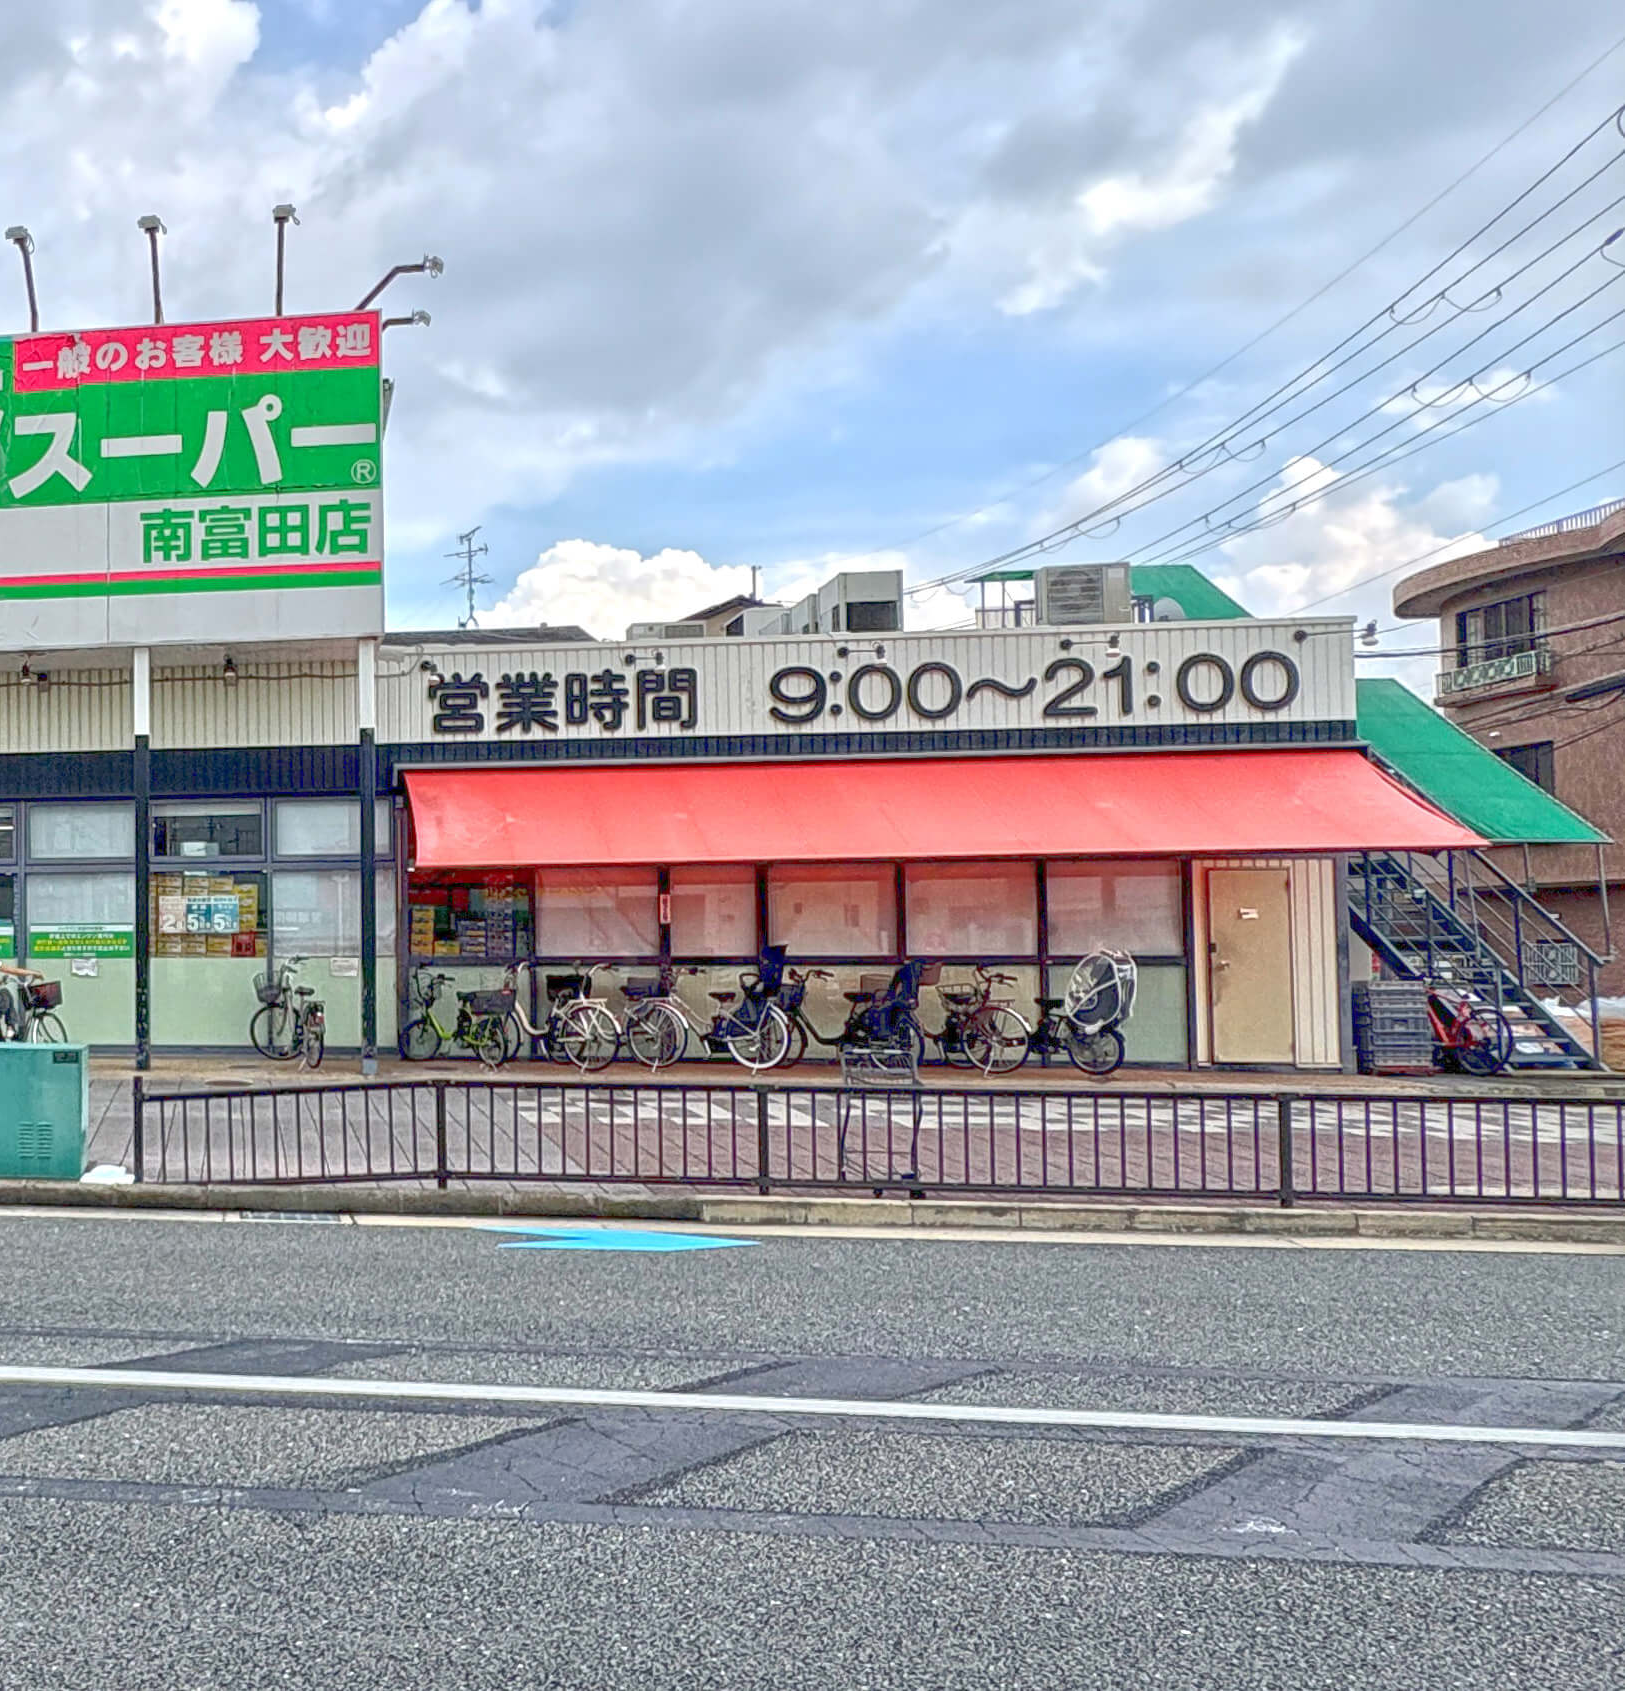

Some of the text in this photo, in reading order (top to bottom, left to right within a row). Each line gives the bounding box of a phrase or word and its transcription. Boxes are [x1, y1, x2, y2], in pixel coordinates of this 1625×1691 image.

[22, 323, 372, 379] 一般のお客様 大歓迎
[139, 499, 372, 564] 南富田店
[428, 667, 698, 734] 営業時間
